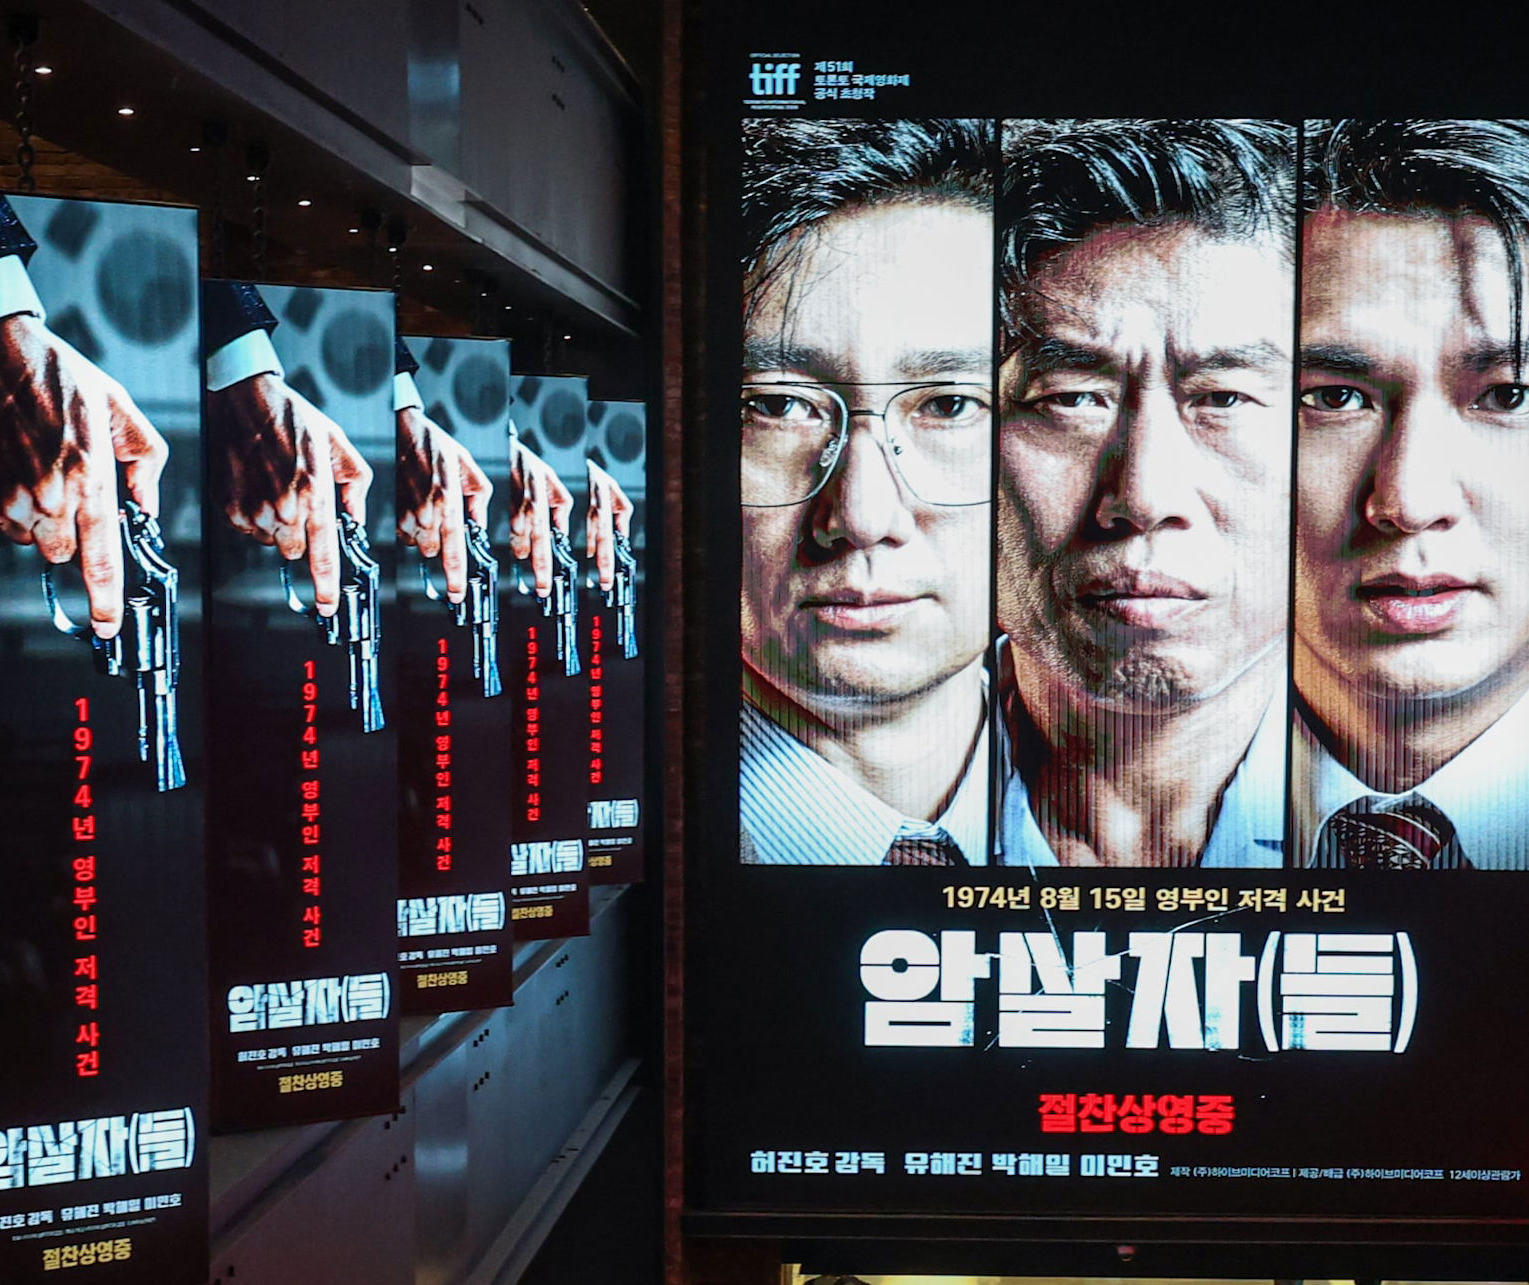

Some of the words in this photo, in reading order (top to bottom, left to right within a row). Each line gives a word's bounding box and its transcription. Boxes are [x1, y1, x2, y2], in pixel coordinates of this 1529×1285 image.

[749, 62, 801, 96] tiff
[813, 74, 850, 87] 토론토
[851, 74, 910, 87] 국제영화제
[813, 87, 838, 100] 공식
[434, 638, 452, 728] 1974년
[300, 660, 321, 770] 1974년
[71, 697, 97, 842] 1974년
[300, 779, 321, 846] 영부인
[587, 799, 639, 829] 자(들)
[301, 854, 322, 897] 저격
[71, 855, 98, 941] 영부인
[942, 886, 1031, 910] 1974년
[1039, 887, 1080, 910] 8월
[1088, 887, 1146, 911] 15일
[1155, 887, 1229, 912] 영부인
[1238, 888, 1287, 912] 저격
[1296, 889, 1346, 913] 사건
[301, 905, 323, 949] 사건
[73, 954, 99, 1011] 저격
[227, 972, 390, 1033] 암살자(들)
[859, 929, 1419, 1054] 암살자(들)
[75, 1021, 101, 1078] 사건
[278, 1070, 343, 1093] 절찬상영중
[1037, 1092, 1237, 1136] 절찬상영중
[749, 1149, 830, 1174] 허진호
[834, 1151, 886, 1175] 감독
[903, 1151, 983, 1176] 유해진
[991, 1152, 1071, 1177] 박해일
[1079, 1153, 1160, 1178] 이민호
[1169, 1166, 1190, 1177] 제작
[42, 1238, 133, 1271] 절찬상영중
